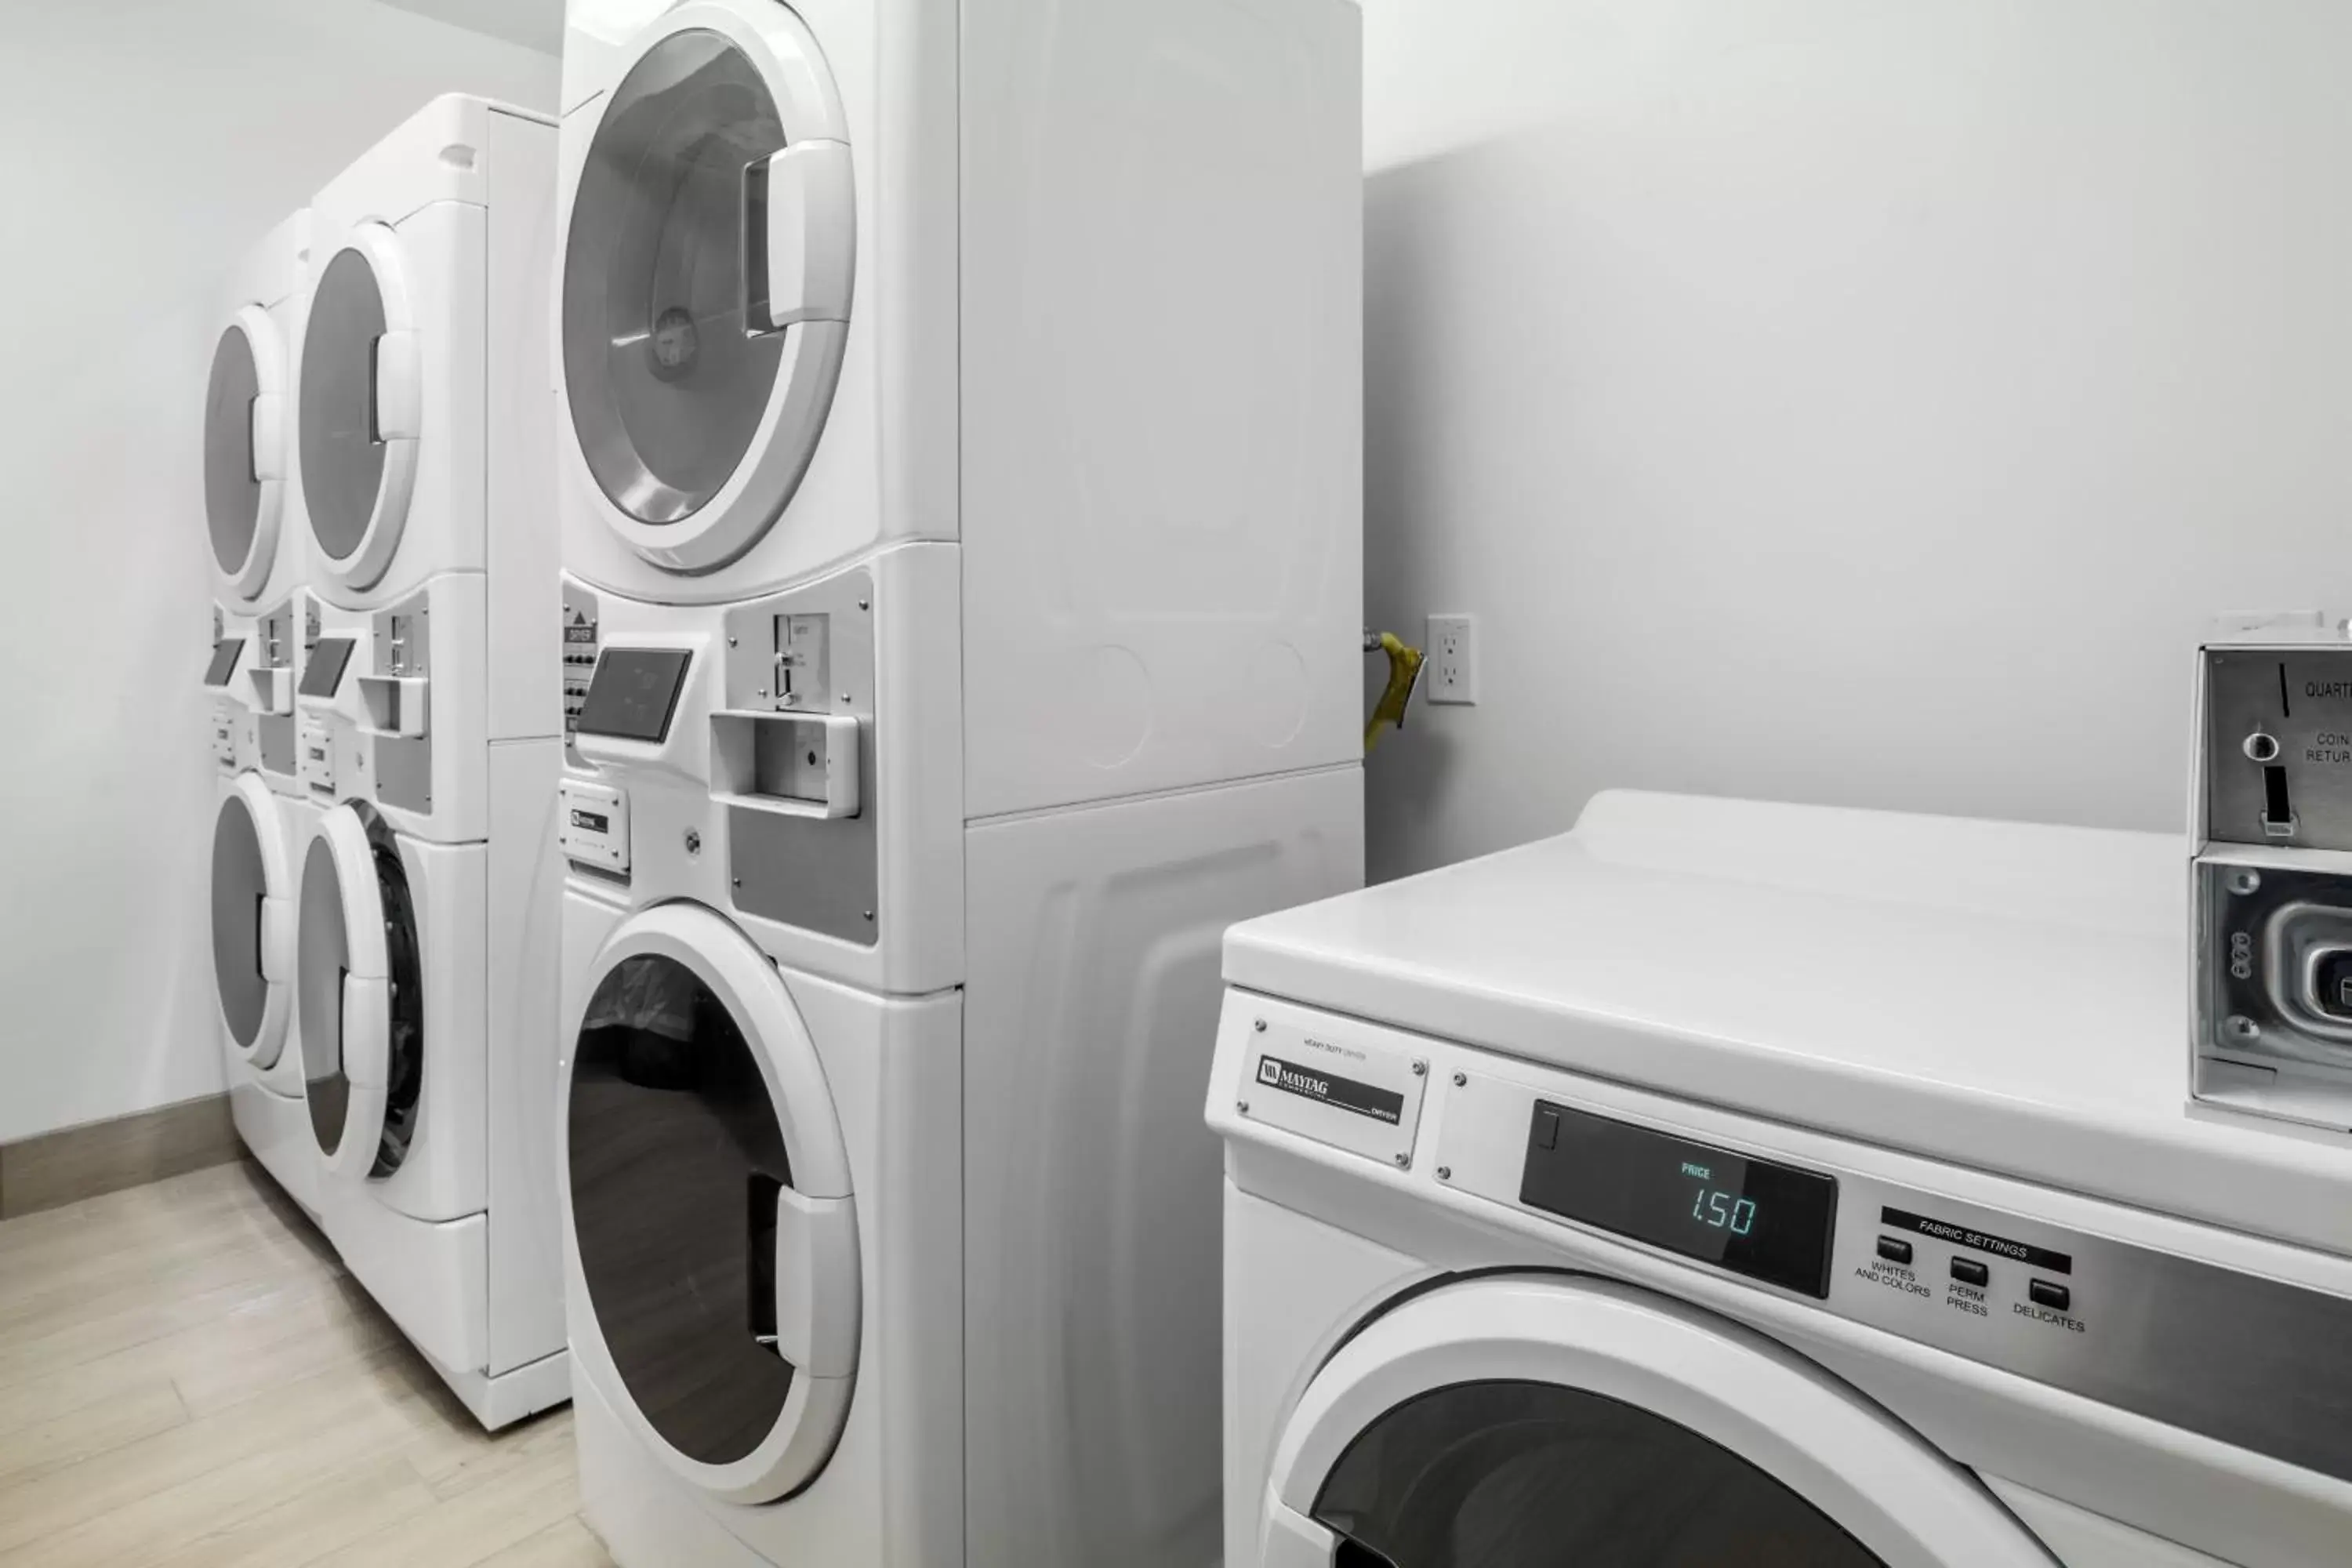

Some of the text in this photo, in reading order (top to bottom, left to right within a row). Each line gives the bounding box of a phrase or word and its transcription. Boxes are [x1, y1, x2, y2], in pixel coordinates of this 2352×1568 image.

[2306, 681, 2352, 698] QUART
[2317, 733, 2349, 746] COIN
[1279, 1069, 1329, 1094] MAYTAG
[1681, 1162, 1711, 1180] PRICE
[1693, 1189, 1755, 1235] 1.50
[1919, 1220, 2028, 1258] FABRIC SETTINGS
[1871, 1260, 1916, 1282] WHITES
[1854, 1267, 1931, 1298] AND COLORS
[1948, 1283, 1984, 1303] PERM
[1947, 1296, 1988, 1317] PRESS
[2013, 1301, 2086, 1333] DELICATES
